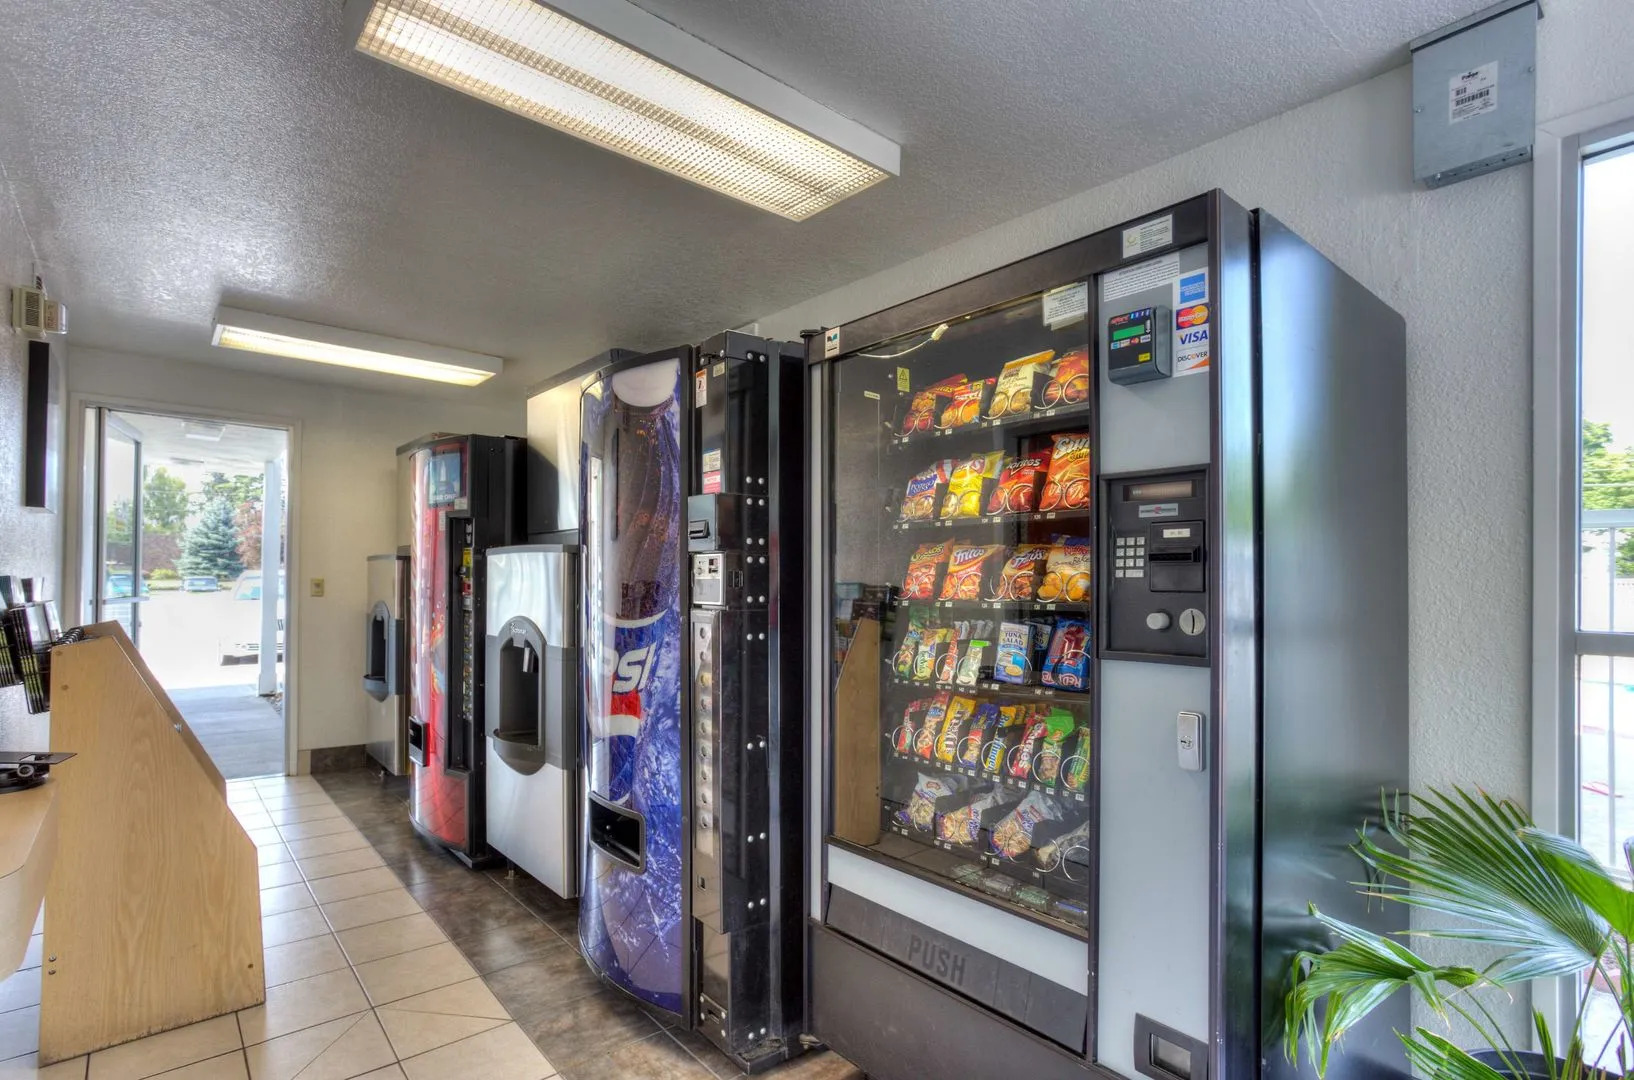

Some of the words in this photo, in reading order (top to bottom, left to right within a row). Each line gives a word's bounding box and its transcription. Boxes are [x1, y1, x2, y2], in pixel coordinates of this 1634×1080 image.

[1180, 330, 1208, 345] VISA
[1177, 351, 1208, 363] DISCOVER
[1005, 631, 1023, 640] TUNA
[908, 934, 966, 986] PUSH
